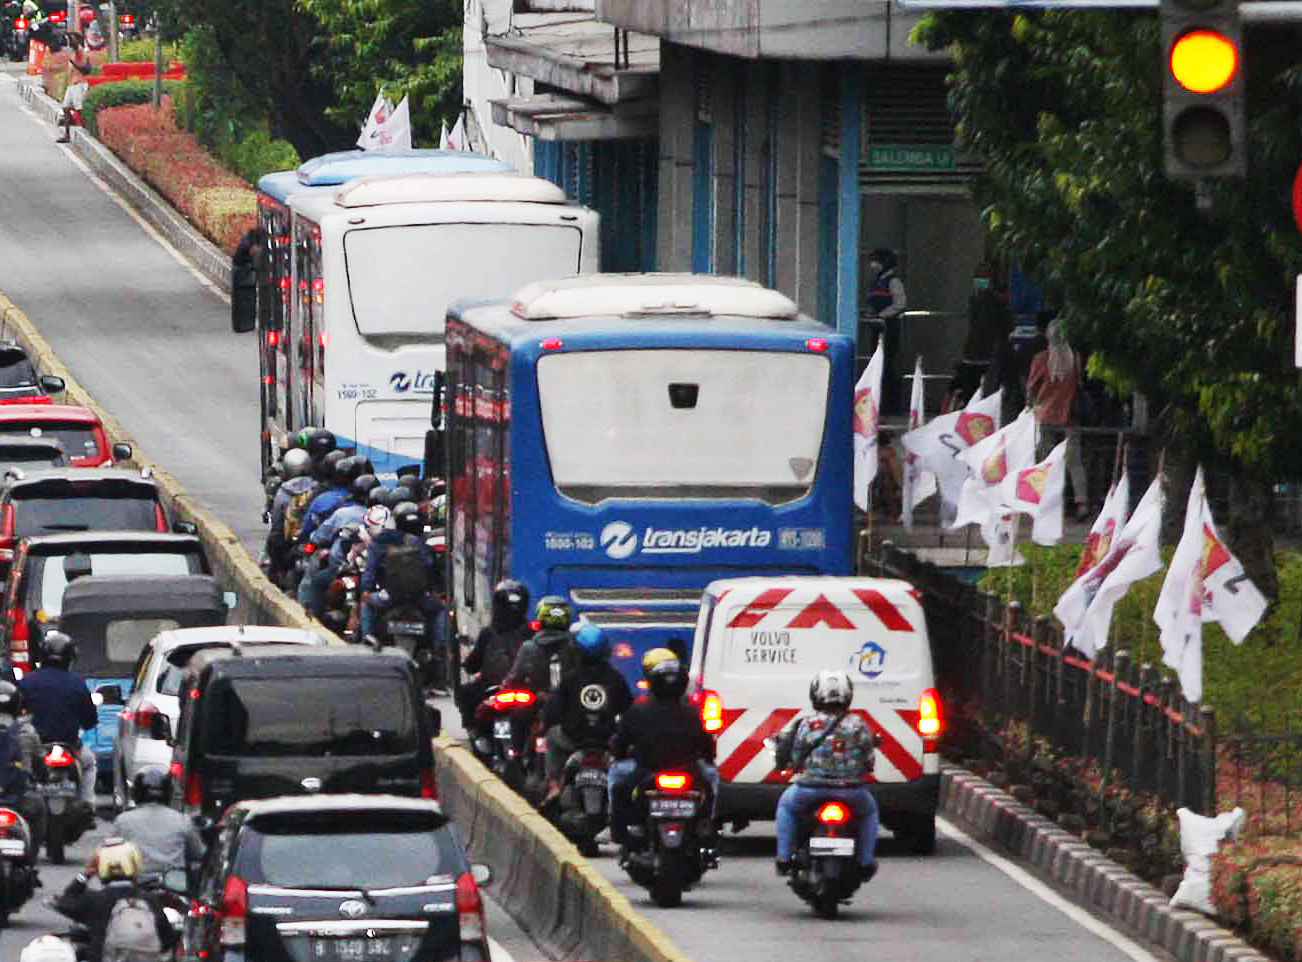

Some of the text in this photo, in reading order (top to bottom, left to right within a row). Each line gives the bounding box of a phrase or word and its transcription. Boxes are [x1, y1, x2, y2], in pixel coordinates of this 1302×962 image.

[642, 527, 772, 553] transjakarta
[750, 631, 791, 646] VOLVO
[744, 649, 797, 664] SERVICE
